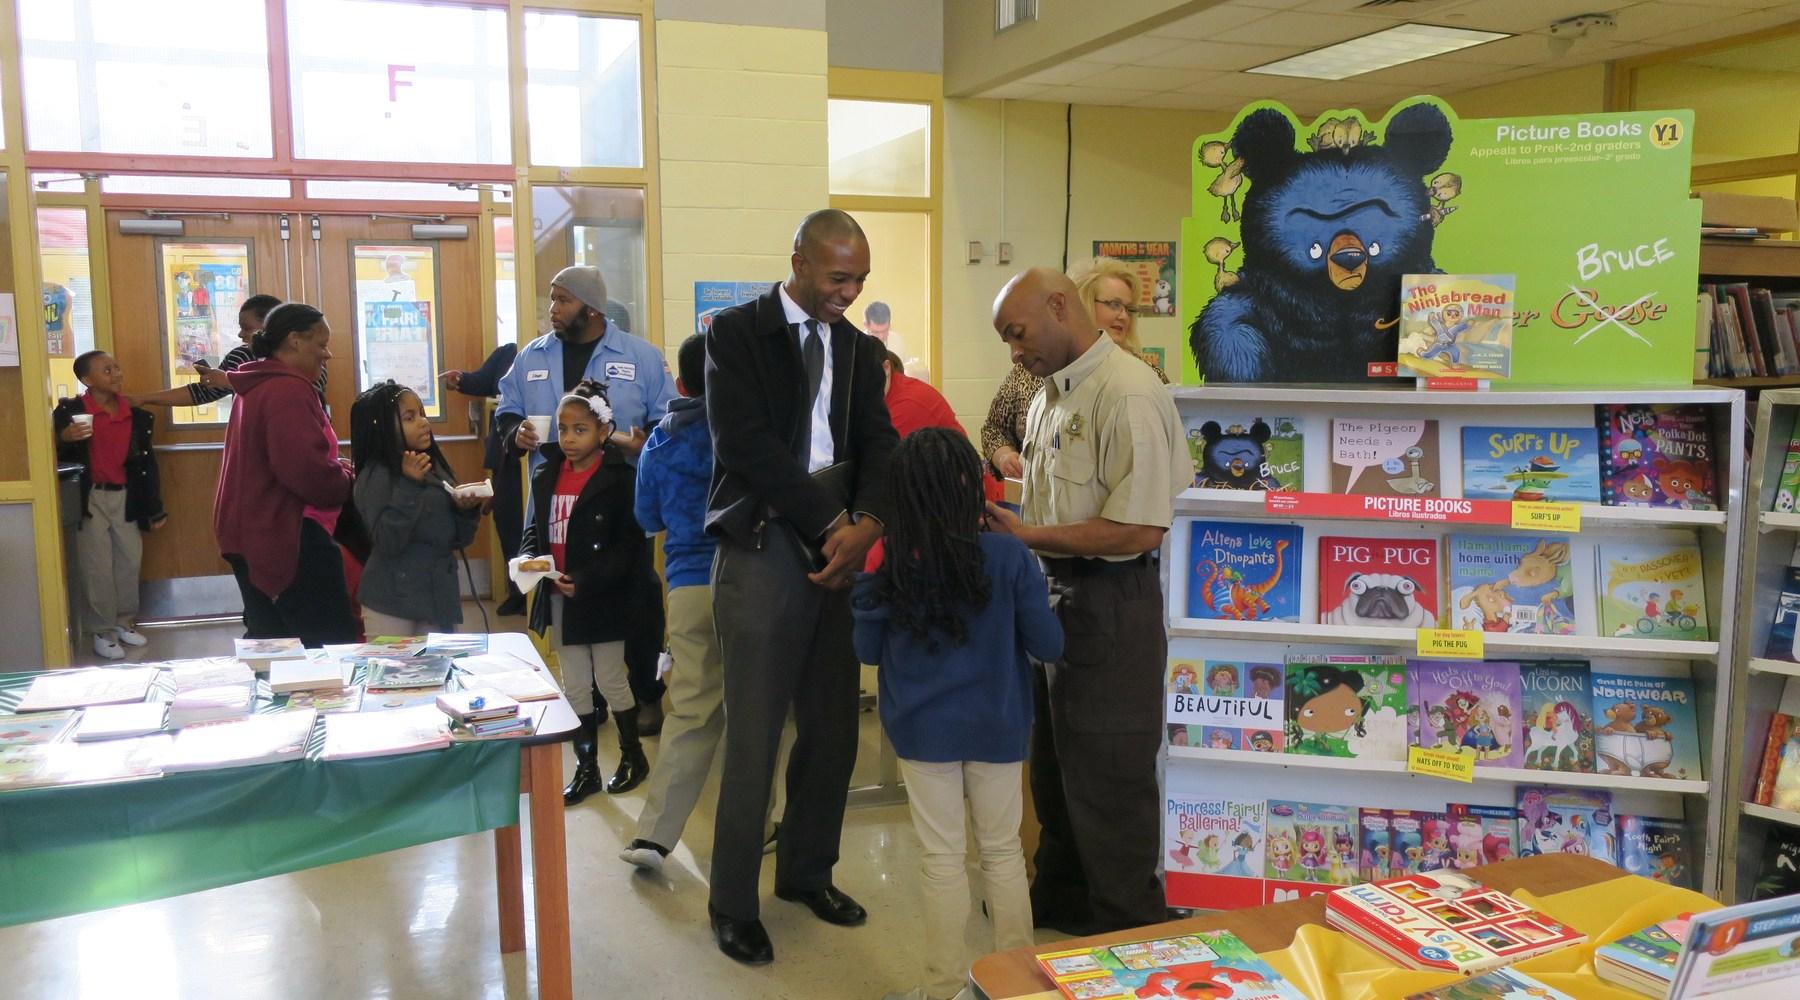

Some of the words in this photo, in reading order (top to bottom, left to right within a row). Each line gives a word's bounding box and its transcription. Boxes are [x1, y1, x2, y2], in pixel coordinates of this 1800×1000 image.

[387, 64, 416, 102] F
[1496, 124, 1570, 142] Picture
[1577, 120, 1642, 138] Books
[1654, 123, 1679, 141] Y1
[1470, 146, 1517, 157] Appeals
[1520, 144, 1532, 154] to
[1595, 140, 1641, 152] graders
[1505, 156, 1532, 165] Libros
[1533, 156, 1553, 165] para
[1408, 283, 1437, 300] The
[1408, 290, 1506, 314] Ninjabread
[1551, 288, 1668, 329] Goose
[1467, 304, 1501, 318] Man
[1339, 423, 1364, 432] The
[1369, 422, 1417, 435] Pigeon
[1339, 436, 1380, 446] Needs
[1549, 432, 1581, 461] UP
[1655, 440, 1706, 458] PANTS
[1339, 450, 1377, 460] Bath!
[1364, 496, 1425, 512] PICTURE
[1426, 498, 1472, 514] BOOKS
[1388, 510, 1411, 519] Libros
[1530, 512, 1551, 520] SURF'S
[1552, 513, 1561, 521] UP
[1333, 545, 1372, 563] PIG
[1383, 548, 1432, 565] PUG
[1458, 552, 1491, 564] home
[1494, 553, 1521, 565] with
[1444, 640, 1455, 648] THE
[1456, 640, 1468, 648] PUG
[1416, 757, 1430, 766] HATS
[1432, 759, 1442, 767] OFF
[1443, 761, 1450, 769] TO
[1452, 763, 1466, 772] YOU!
[1167, 800, 1226, 816] Princess!
[1227, 801, 1265, 822] Fairy!
[1179, 813, 1241, 832] Ballerina!
[1752, 919, 1777, 932] STEP
[1725, 927, 1735, 943] 1
